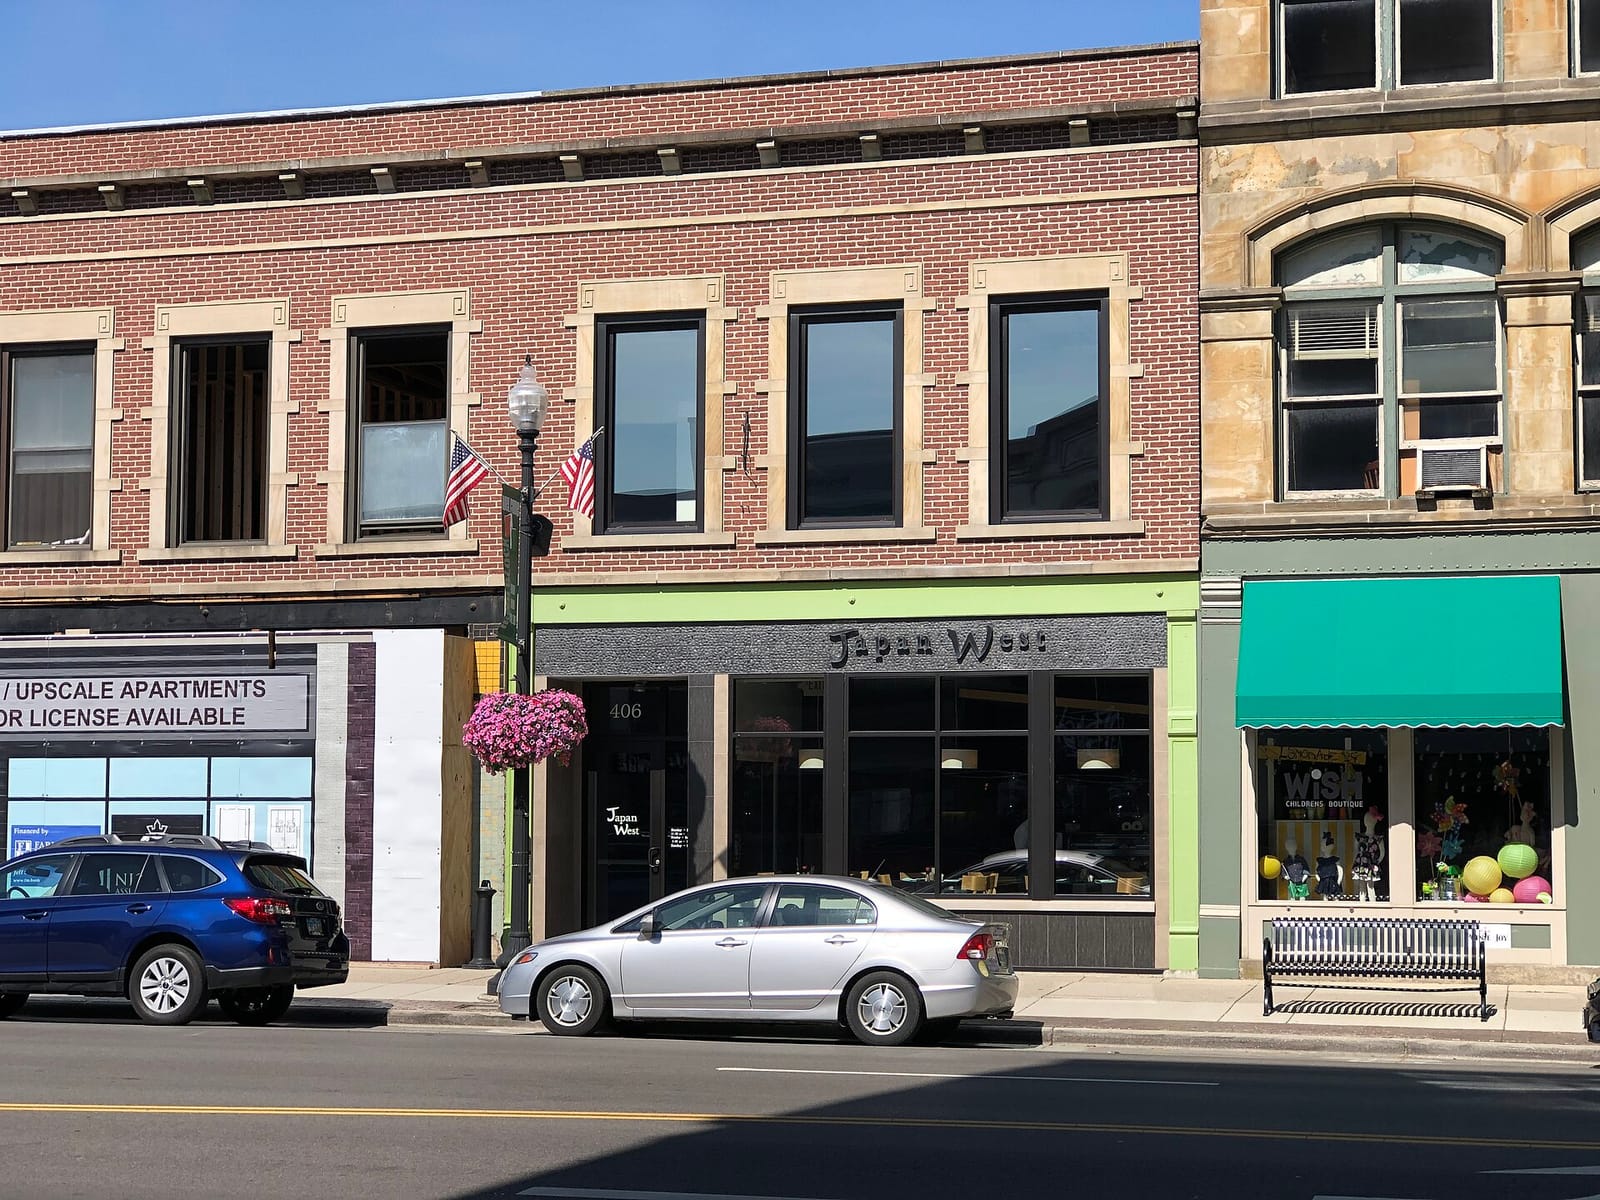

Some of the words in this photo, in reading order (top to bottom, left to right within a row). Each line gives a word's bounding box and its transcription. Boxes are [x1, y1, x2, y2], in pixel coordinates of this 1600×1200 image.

[829, 628, 933, 668] Japan
[947, 625, 1047, 664] West
[16, 681, 114, 700] UPSCALE
[120, 679, 266, 699] APARTMENTS
[30, 708, 120, 727] LICENSE
[126, 707, 246, 726] AVAILABLE
[609, 703, 642, 719] 406
[1285, 800, 1324, 808] CHILDRENS
[1328, 800, 1364, 808] BOUTIQUE
[606, 807, 638, 824] Japan
[13, 827, 40, 835] Financed
[41, 827, 49, 836] by
[613, 824, 640, 836] West
